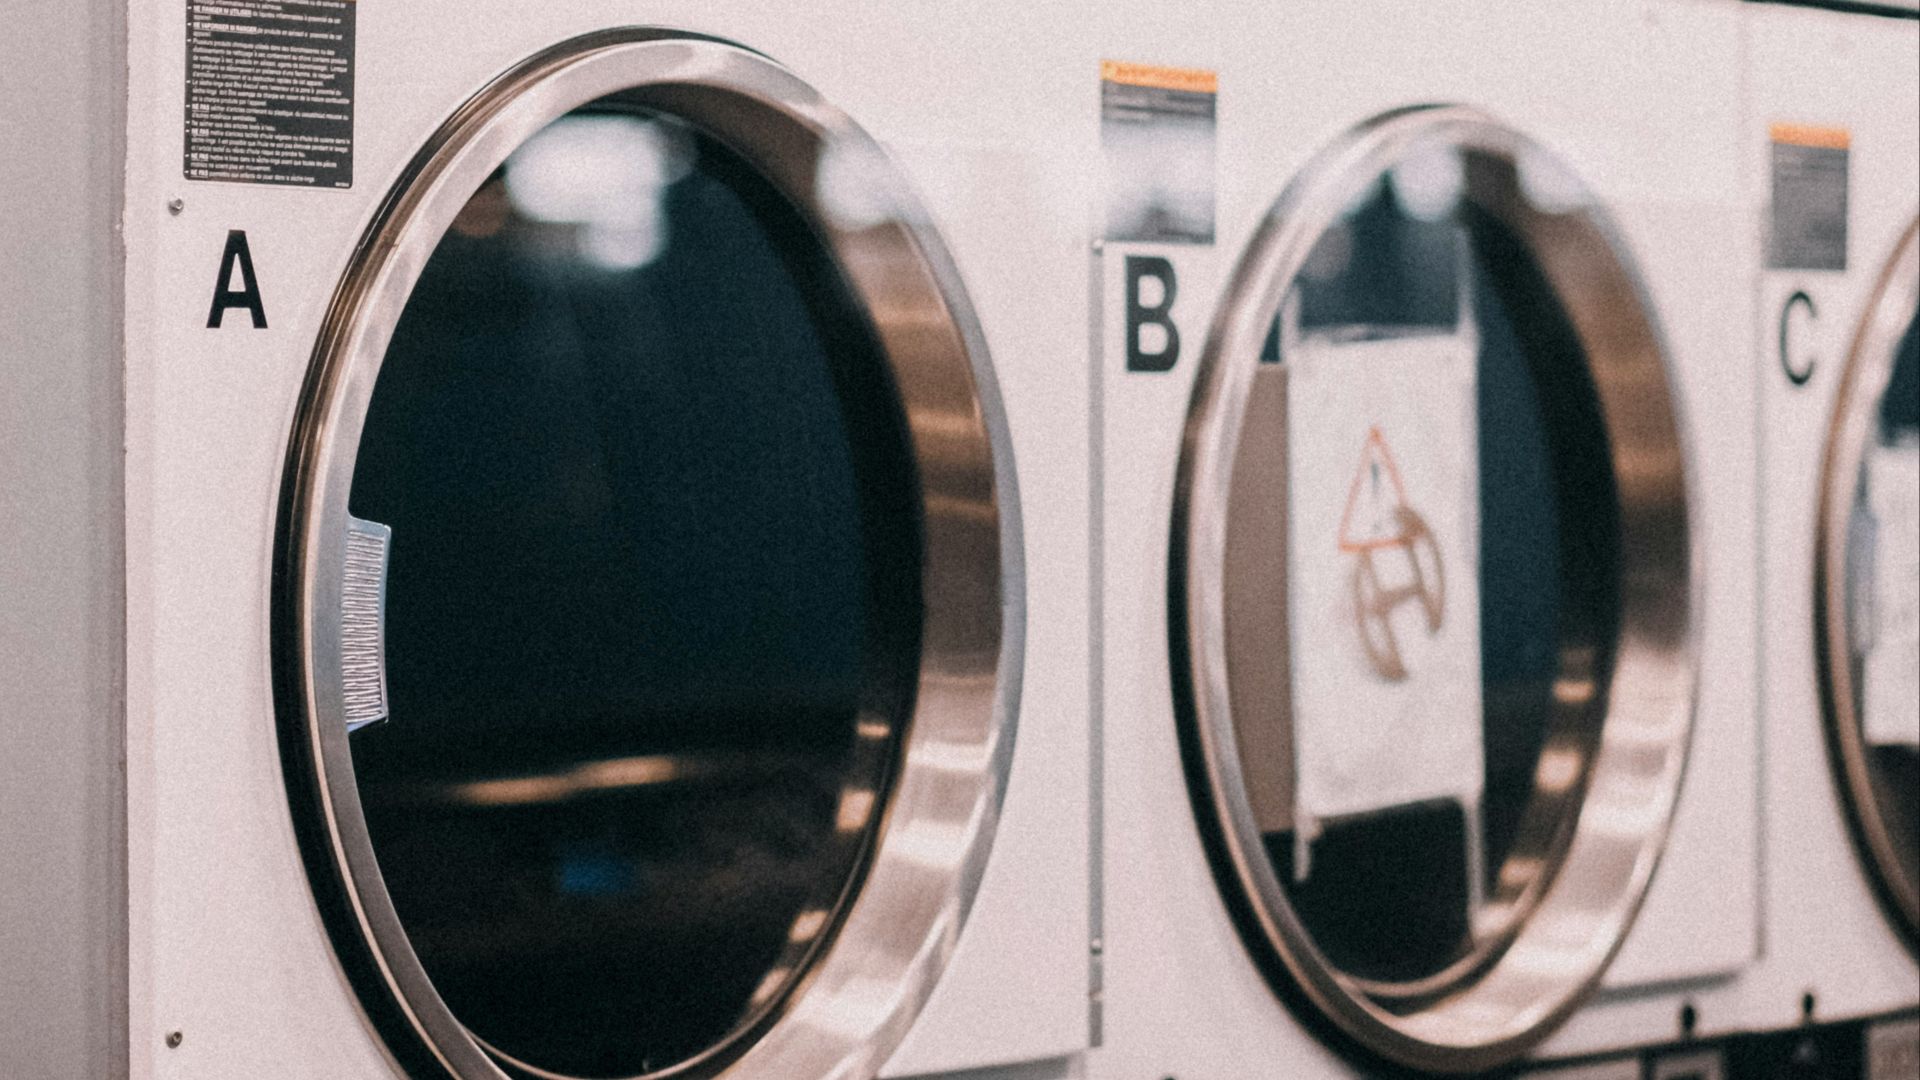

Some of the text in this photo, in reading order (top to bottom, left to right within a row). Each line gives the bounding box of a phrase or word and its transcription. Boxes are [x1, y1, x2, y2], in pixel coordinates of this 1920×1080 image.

[206, 229, 268, 328] A
[1125, 255, 1180, 373] B
[1779, 290, 1817, 386] C
